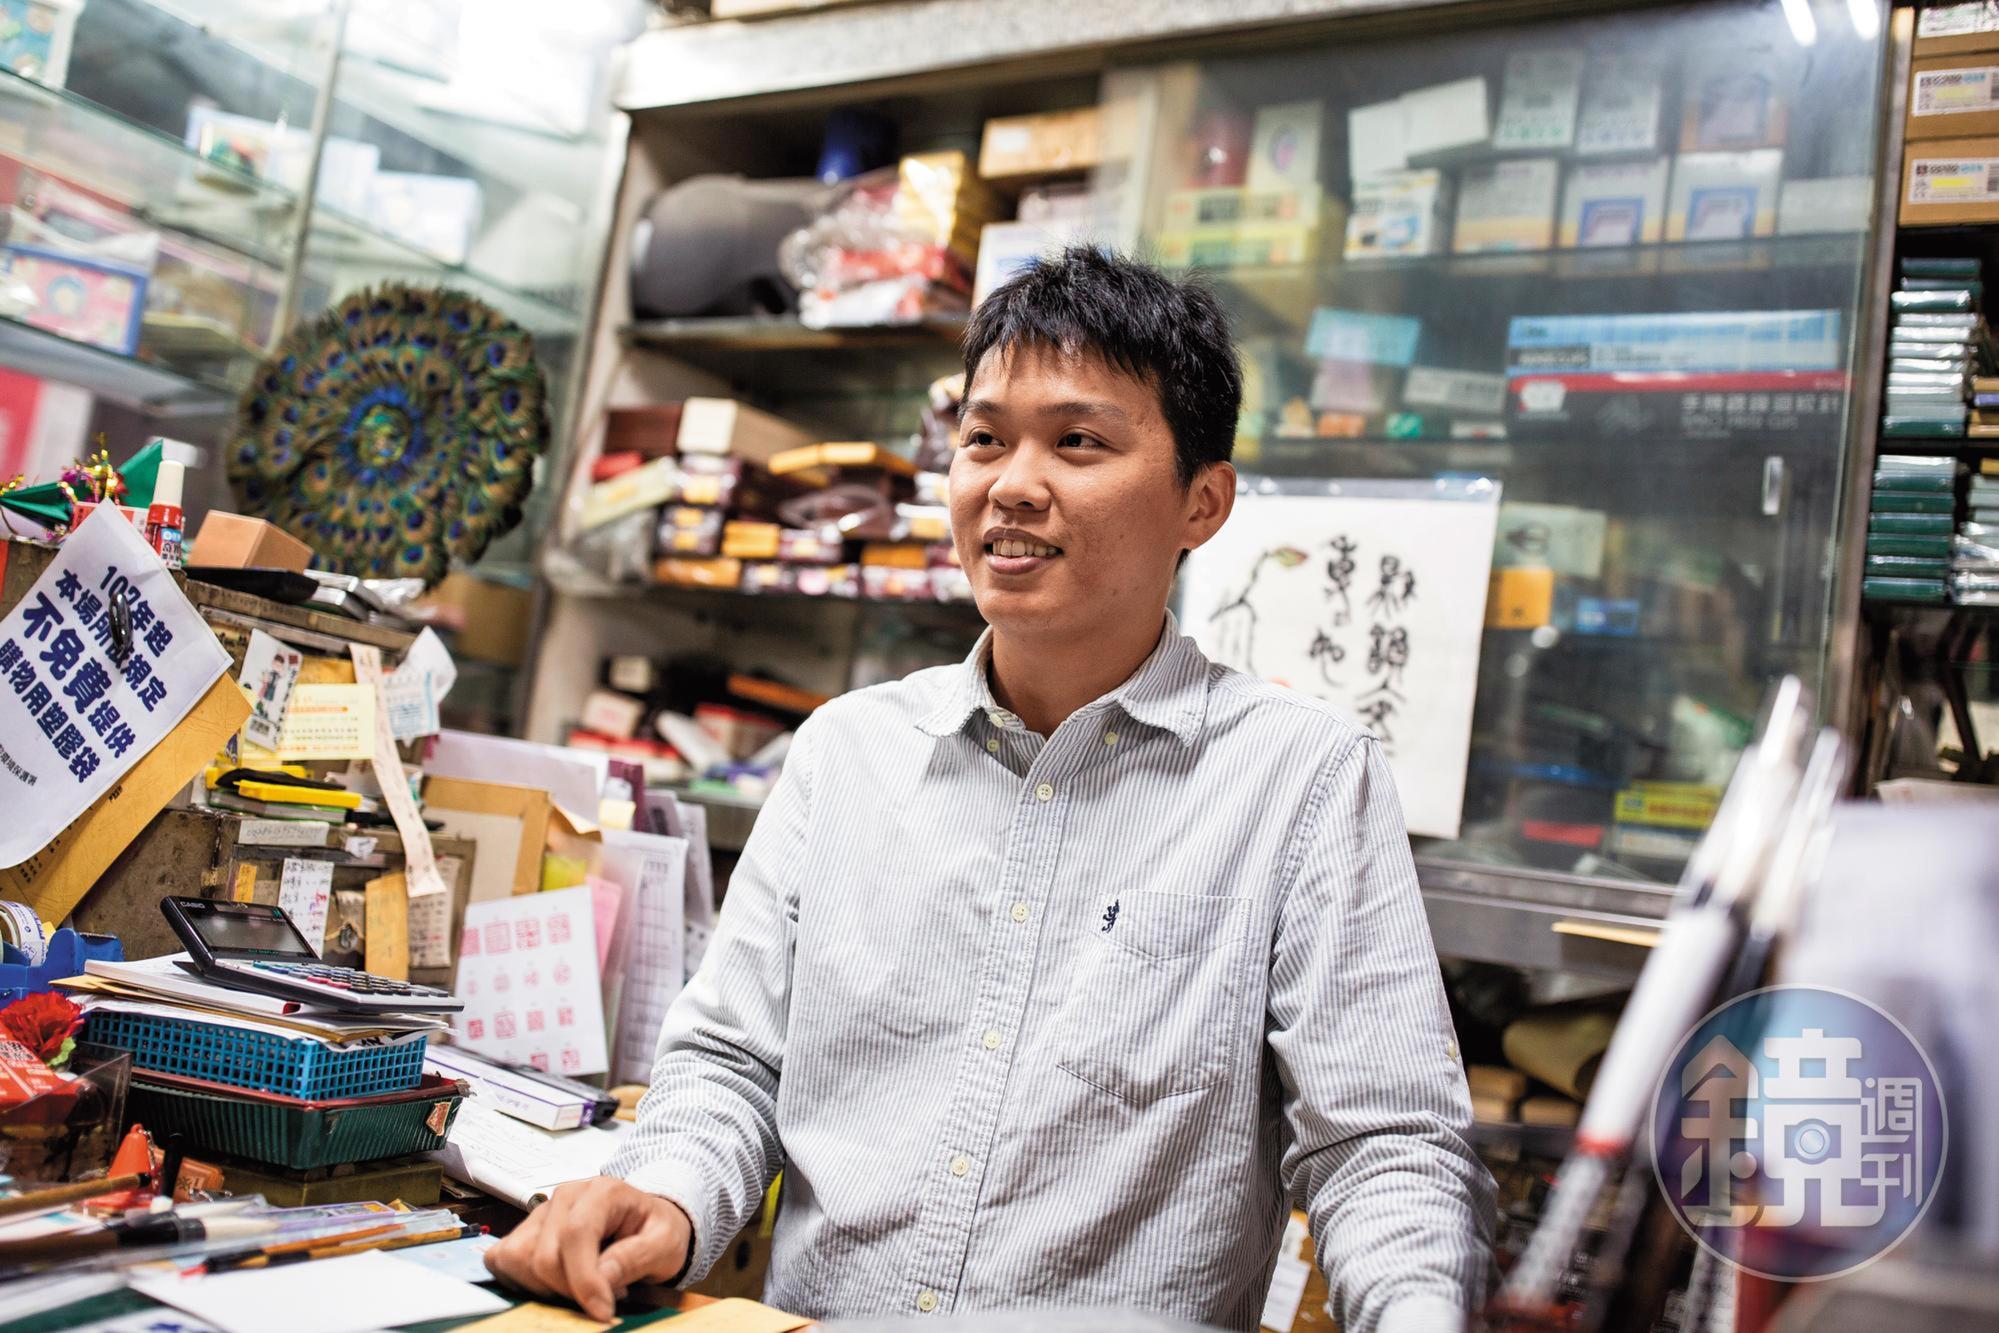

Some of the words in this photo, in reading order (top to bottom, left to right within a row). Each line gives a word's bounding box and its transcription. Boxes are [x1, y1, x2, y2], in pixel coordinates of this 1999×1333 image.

[23, 591, 137, 758] 不免費提供
